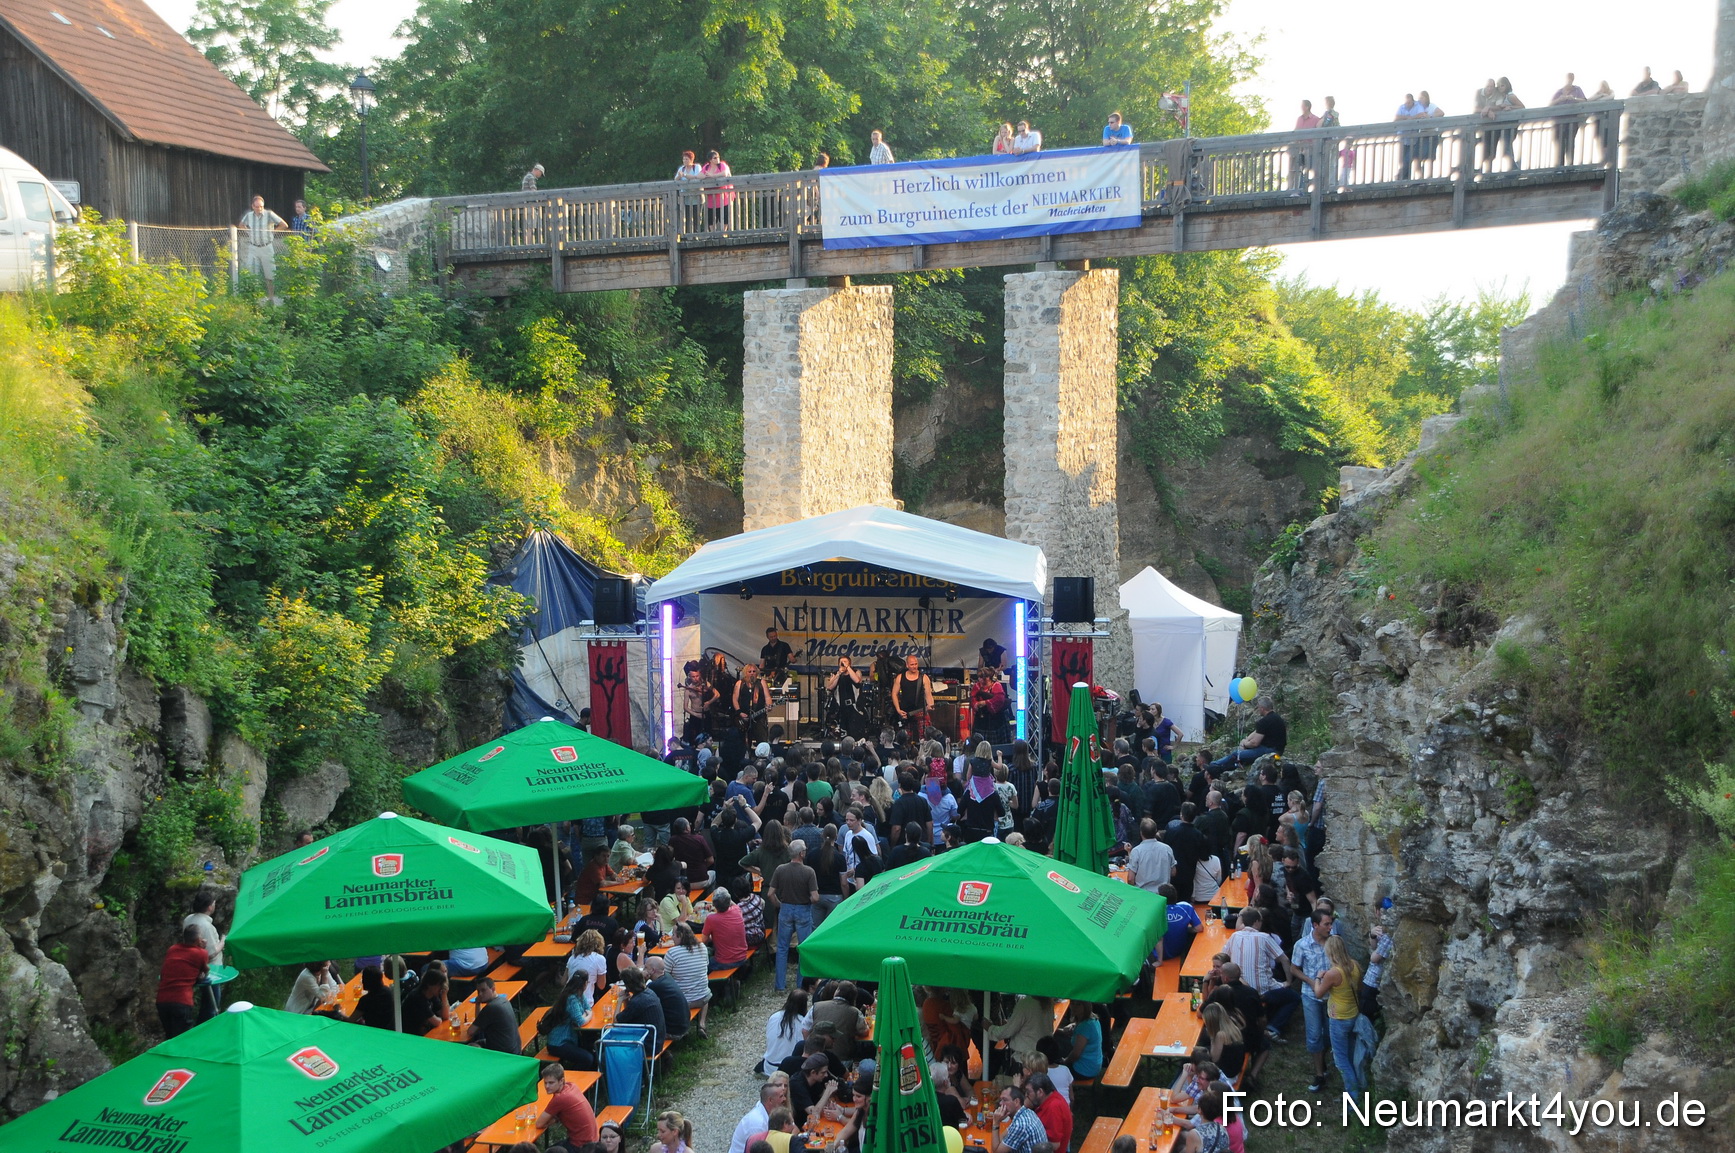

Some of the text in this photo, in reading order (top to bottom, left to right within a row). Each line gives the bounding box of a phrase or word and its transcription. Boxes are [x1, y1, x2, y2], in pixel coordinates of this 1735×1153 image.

[892, 170, 1067, 195] Herzlich willkommen
[1031, 185, 1122, 207] NEUMARKTER
[839, 200, 1029, 228] zum Burgruinenfest der
[1047, 203, 1106, 218] Nachrichten
[772, 606, 966, 634] NEUMARKTER
[525, 767, 625, 787] Lammsbräu
[536, 762, 607, 776] Neumarkter
[324, 886, 454, 910] Lammsbräu
[343, 879, 435, 895] Neumarkter
[324, 912, 343, 920] DAS
[899, 914, 1029, 939] Lammsbräu
[921, 906, 1015, 923] Neumarkter
[294, 1064, 388, 1112] Neumarkter
[288, 1068, 423, 1136] Lammsbräu
[94, 1107, 188, 1133] Neumarkter
[315, 1134, 337, 1148] DAS
[337, 1121, 363, 1138] FEINE
[419, 1085, 439, 1100] BIER
[58, 1119, 189, 1153] Lammsbräu
